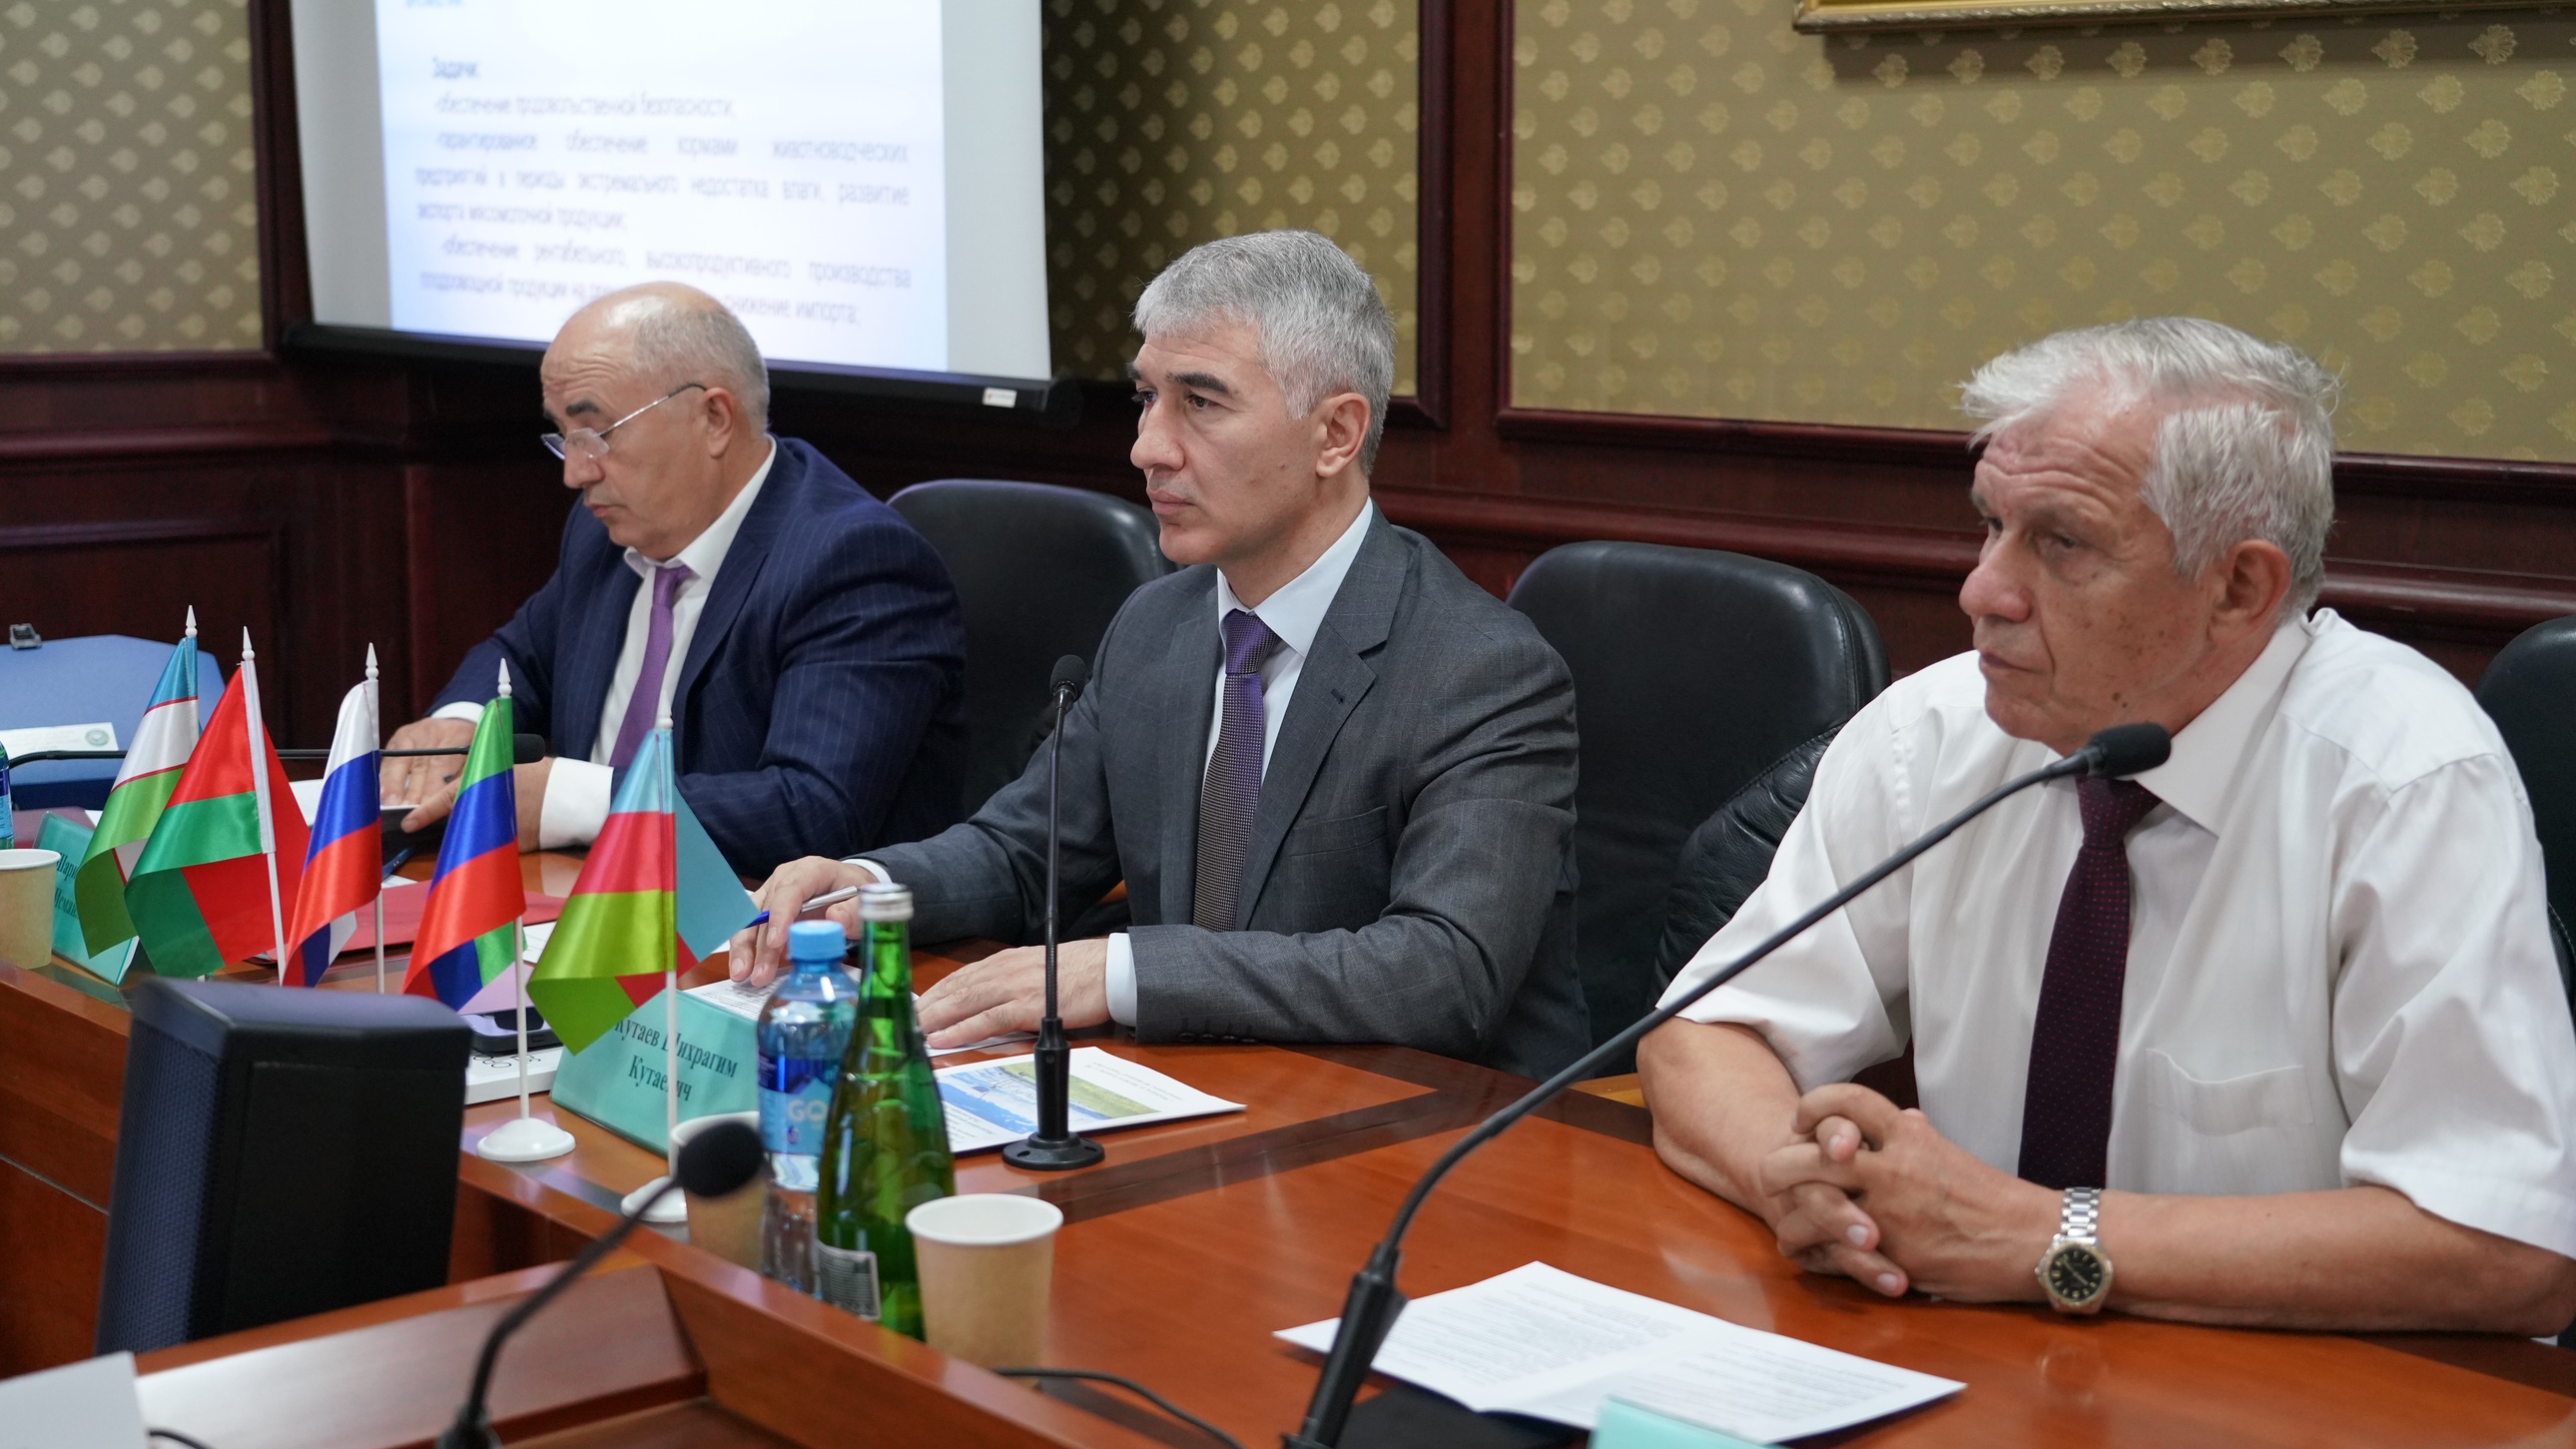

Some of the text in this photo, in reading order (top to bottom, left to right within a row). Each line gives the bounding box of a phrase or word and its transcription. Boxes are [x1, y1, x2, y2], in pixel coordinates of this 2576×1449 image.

[678, 137, 738, 159] кормами
[772, 140, 910, 164] животноводческих
[691, 176, 769, 199] недостатка
[840, 183, 911, 207] развитие
[809, 262, 912, 288] производства
